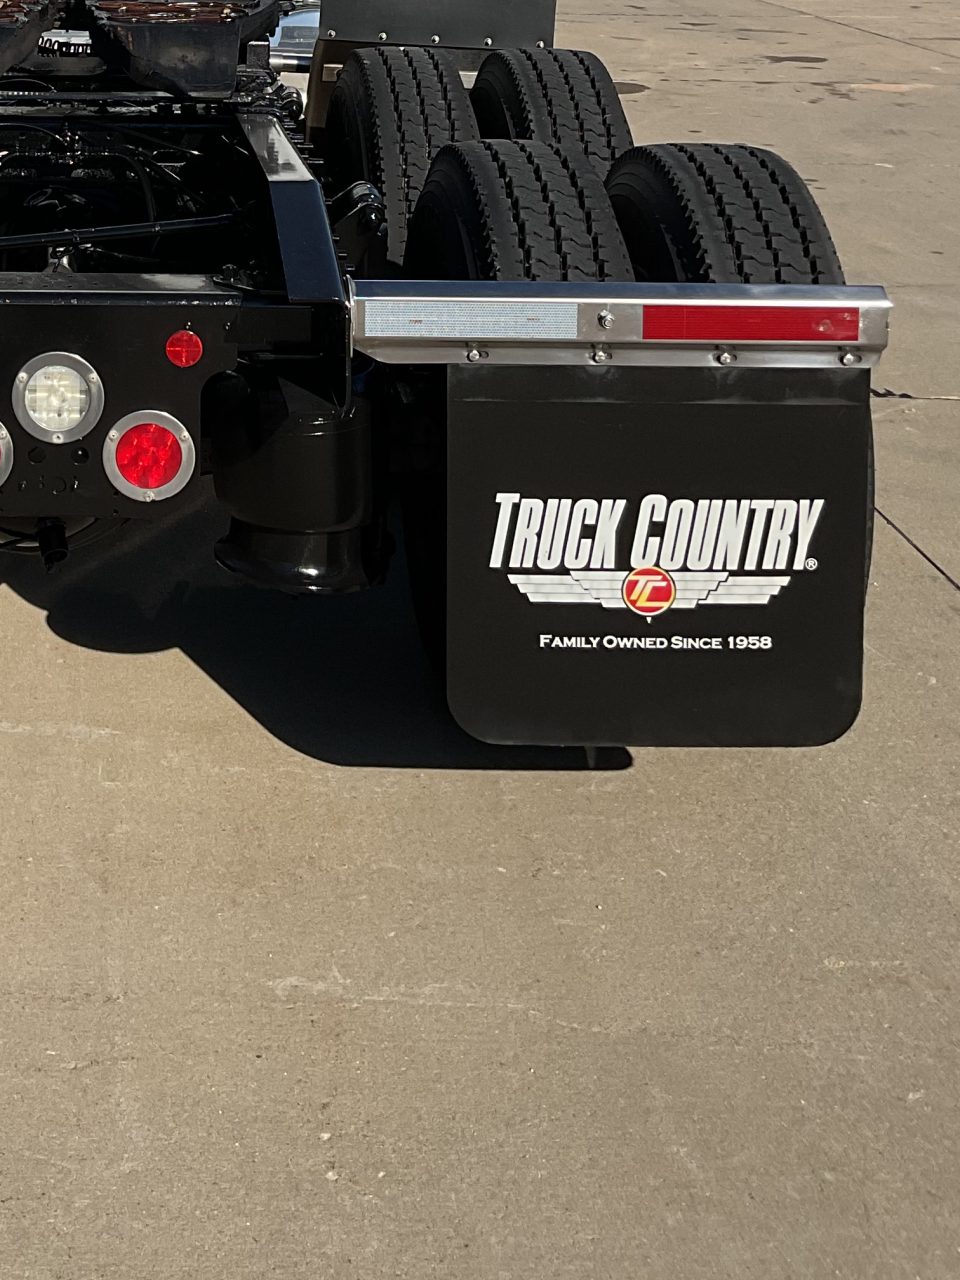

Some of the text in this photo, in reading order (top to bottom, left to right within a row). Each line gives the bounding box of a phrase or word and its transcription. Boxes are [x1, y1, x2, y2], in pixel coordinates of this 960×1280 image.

[489, 492, 627, 570] TRUCK
[539, 634, 773, 650] FAMILY OWNED SINCE 1958
